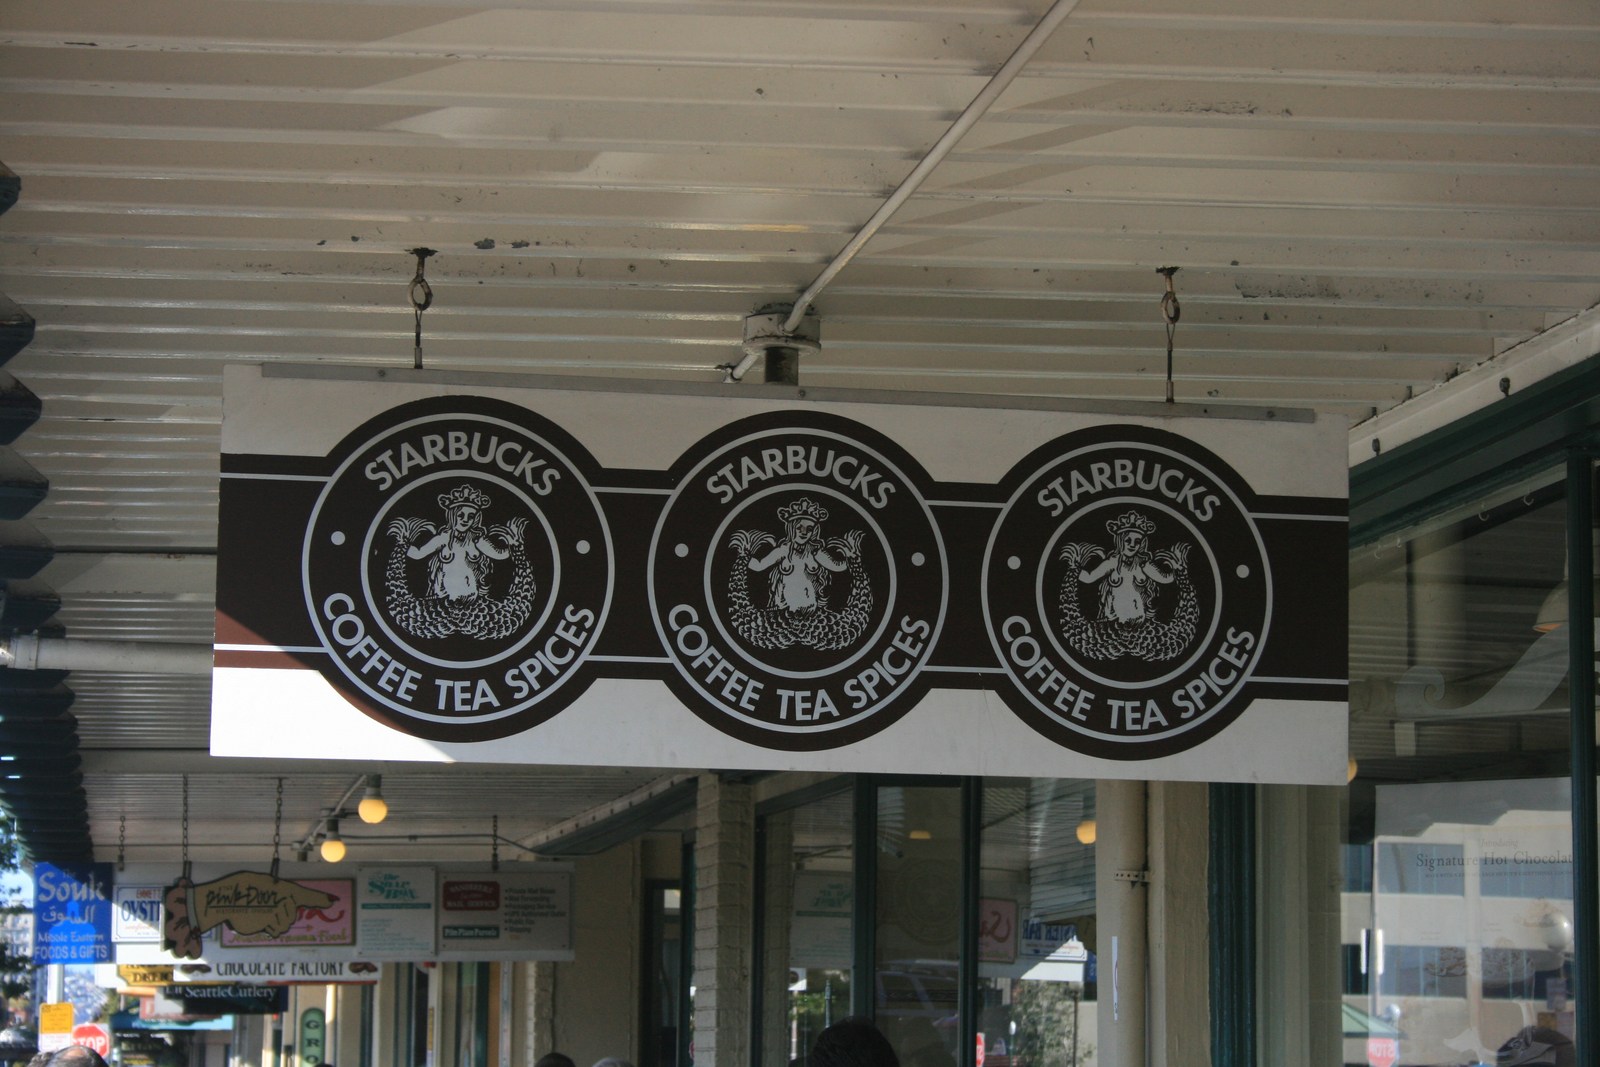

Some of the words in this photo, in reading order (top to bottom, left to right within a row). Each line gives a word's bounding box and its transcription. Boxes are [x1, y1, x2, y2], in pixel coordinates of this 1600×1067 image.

[364, 431, 561, 497] STARBUCKS
[706, 445, 896, 510] STARBUCKS
[1037, 459, 1221, 522] STARBUCKS
[323, 592, 422, 702] COFFEE
[434, 678, 501, 712] TEA
[504, 603, 595, 700] SPICES
[668, 603, 765, 712] COFFEE
[776, 688, 840, 721] TEA
[843, 614, 930, 710] SPICES
[1002, 615, 1096, 722] COFFEE
[1106, 698, 1169, 731] TEA
[1171, 626, 1255, 720] SPICES
[38, 870, 106, 903] Souk
[1416, 852, 1478, 871] Signature
[1484, 851, 1508, 865] Hot
[34, 945, 69, 960] FOODS
[79, 945, 108, 959] GIFTS
